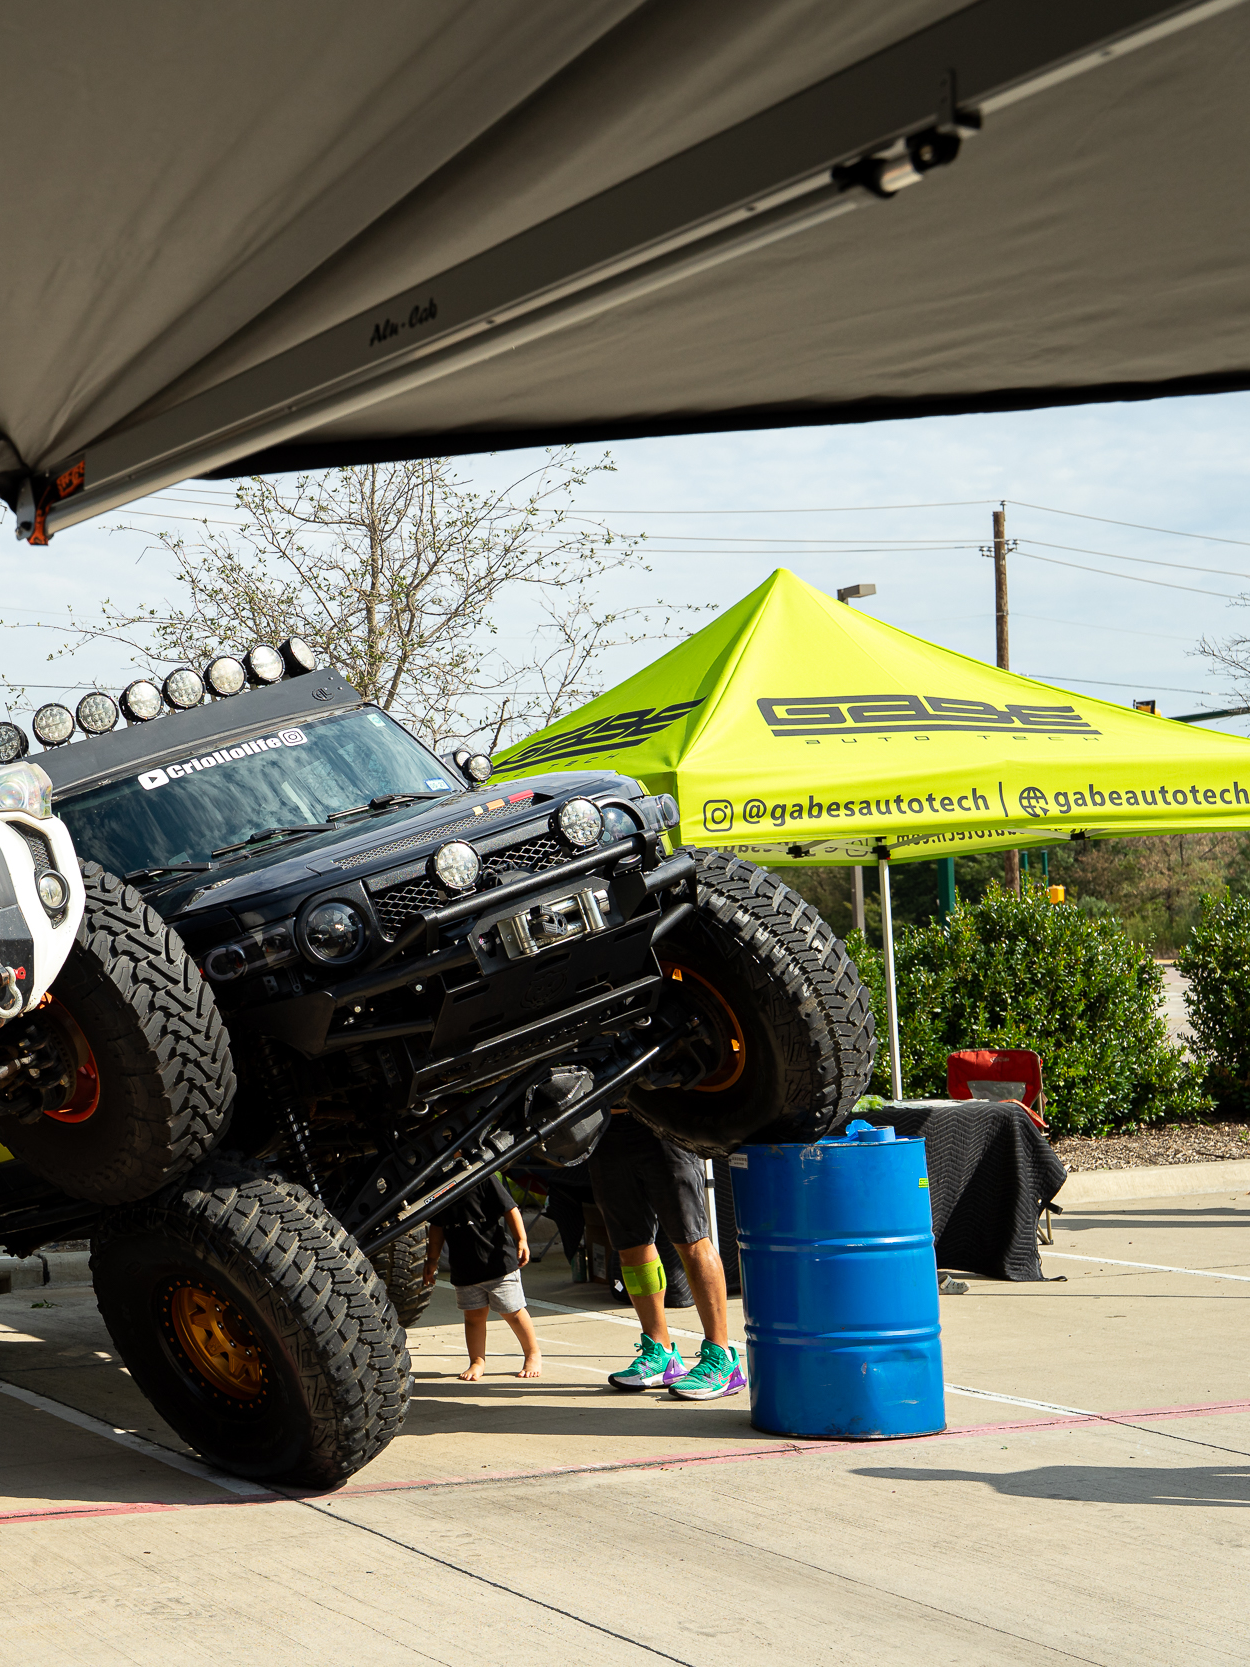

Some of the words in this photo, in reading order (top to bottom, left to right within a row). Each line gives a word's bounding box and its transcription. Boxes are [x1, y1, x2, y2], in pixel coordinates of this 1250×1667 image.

[165, 736, 283, 779] Criollolife
[804, 735, 930, 745] AUTO
[977, 734, 1101, 742] TECH
[742, 787, 990, 827] @gabesautotech
